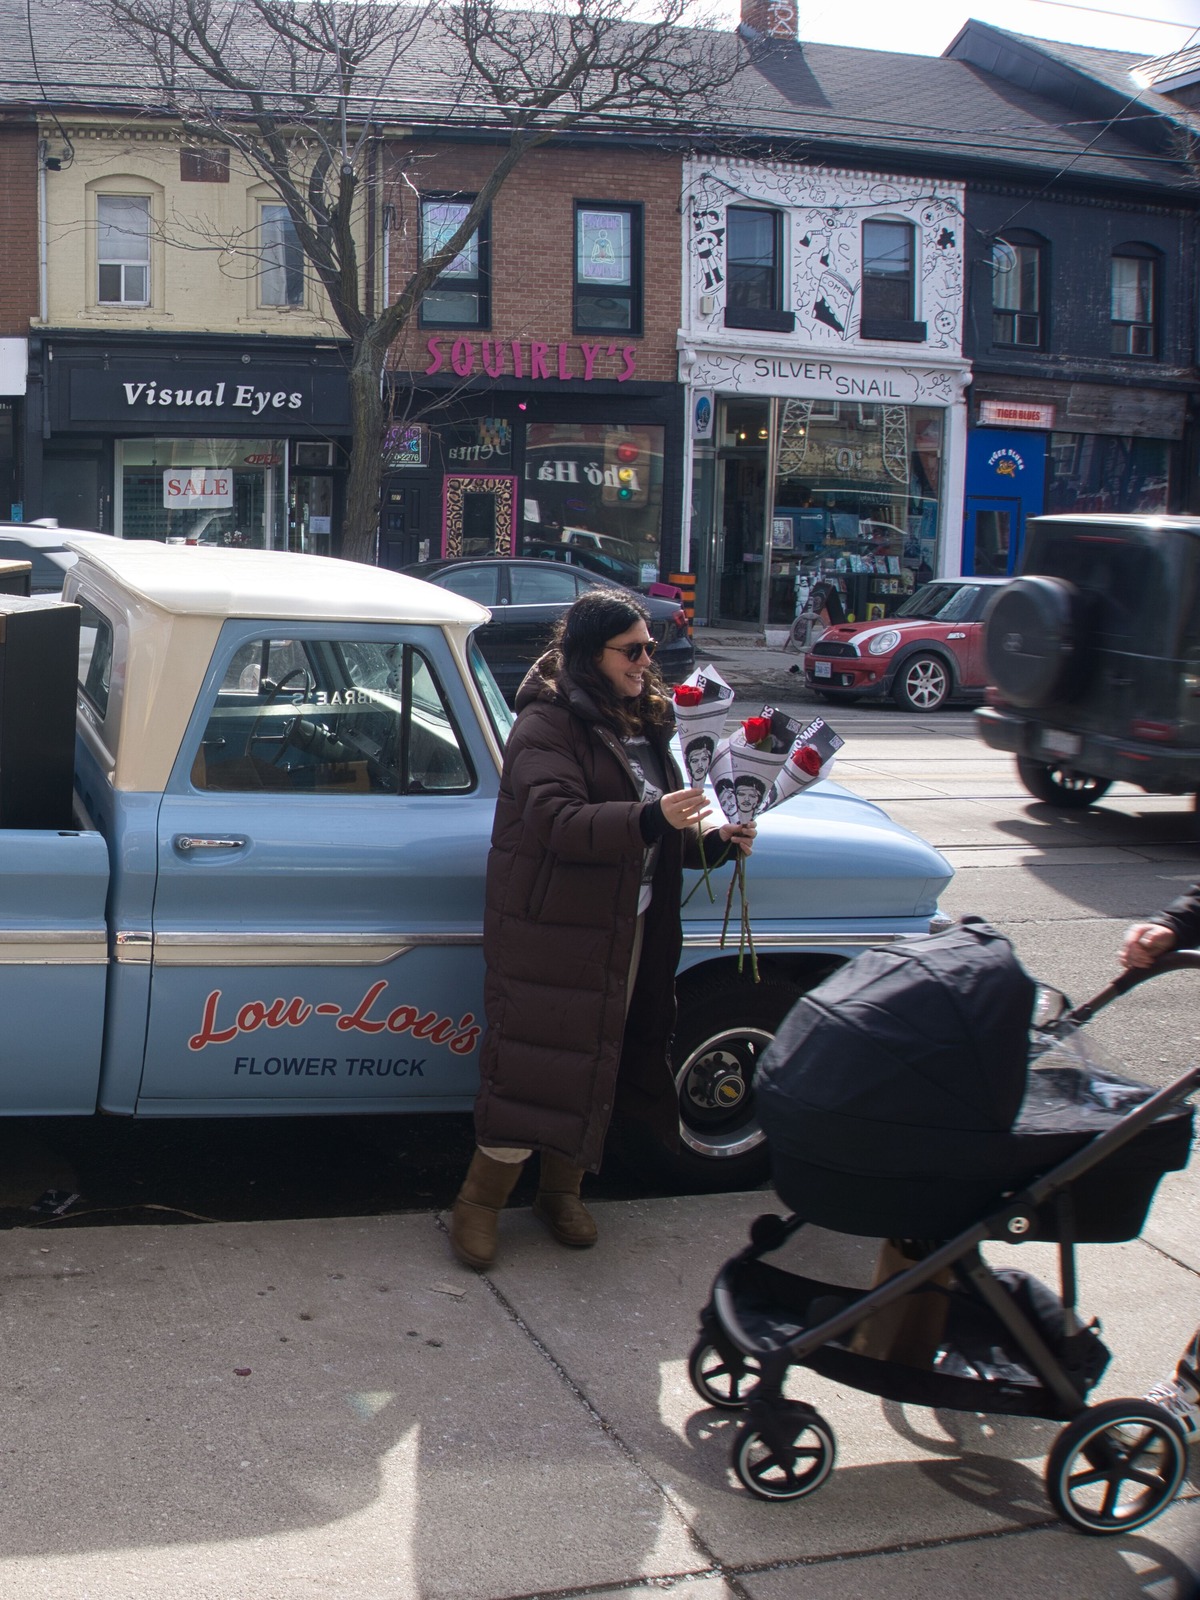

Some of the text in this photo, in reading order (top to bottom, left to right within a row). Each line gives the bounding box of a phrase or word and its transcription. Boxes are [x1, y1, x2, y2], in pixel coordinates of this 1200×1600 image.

[822, 276, 849, 299] COMIC
[425, 336, 637, 382] SQUIRLY'S
[754, 358, 901, 398] SILVER SNAIL
[123, 382, 302, 415] Visual Eyes
[996, 408, 1040, 421] TIGER BLUES
[167, 479, 229, 496] SALE
[800, 717, 824, 741] MARS
[188, 979, 482, 1056] Lou-Lou's
[233, 1057, 427, 1077] FLOWER TRUCK
